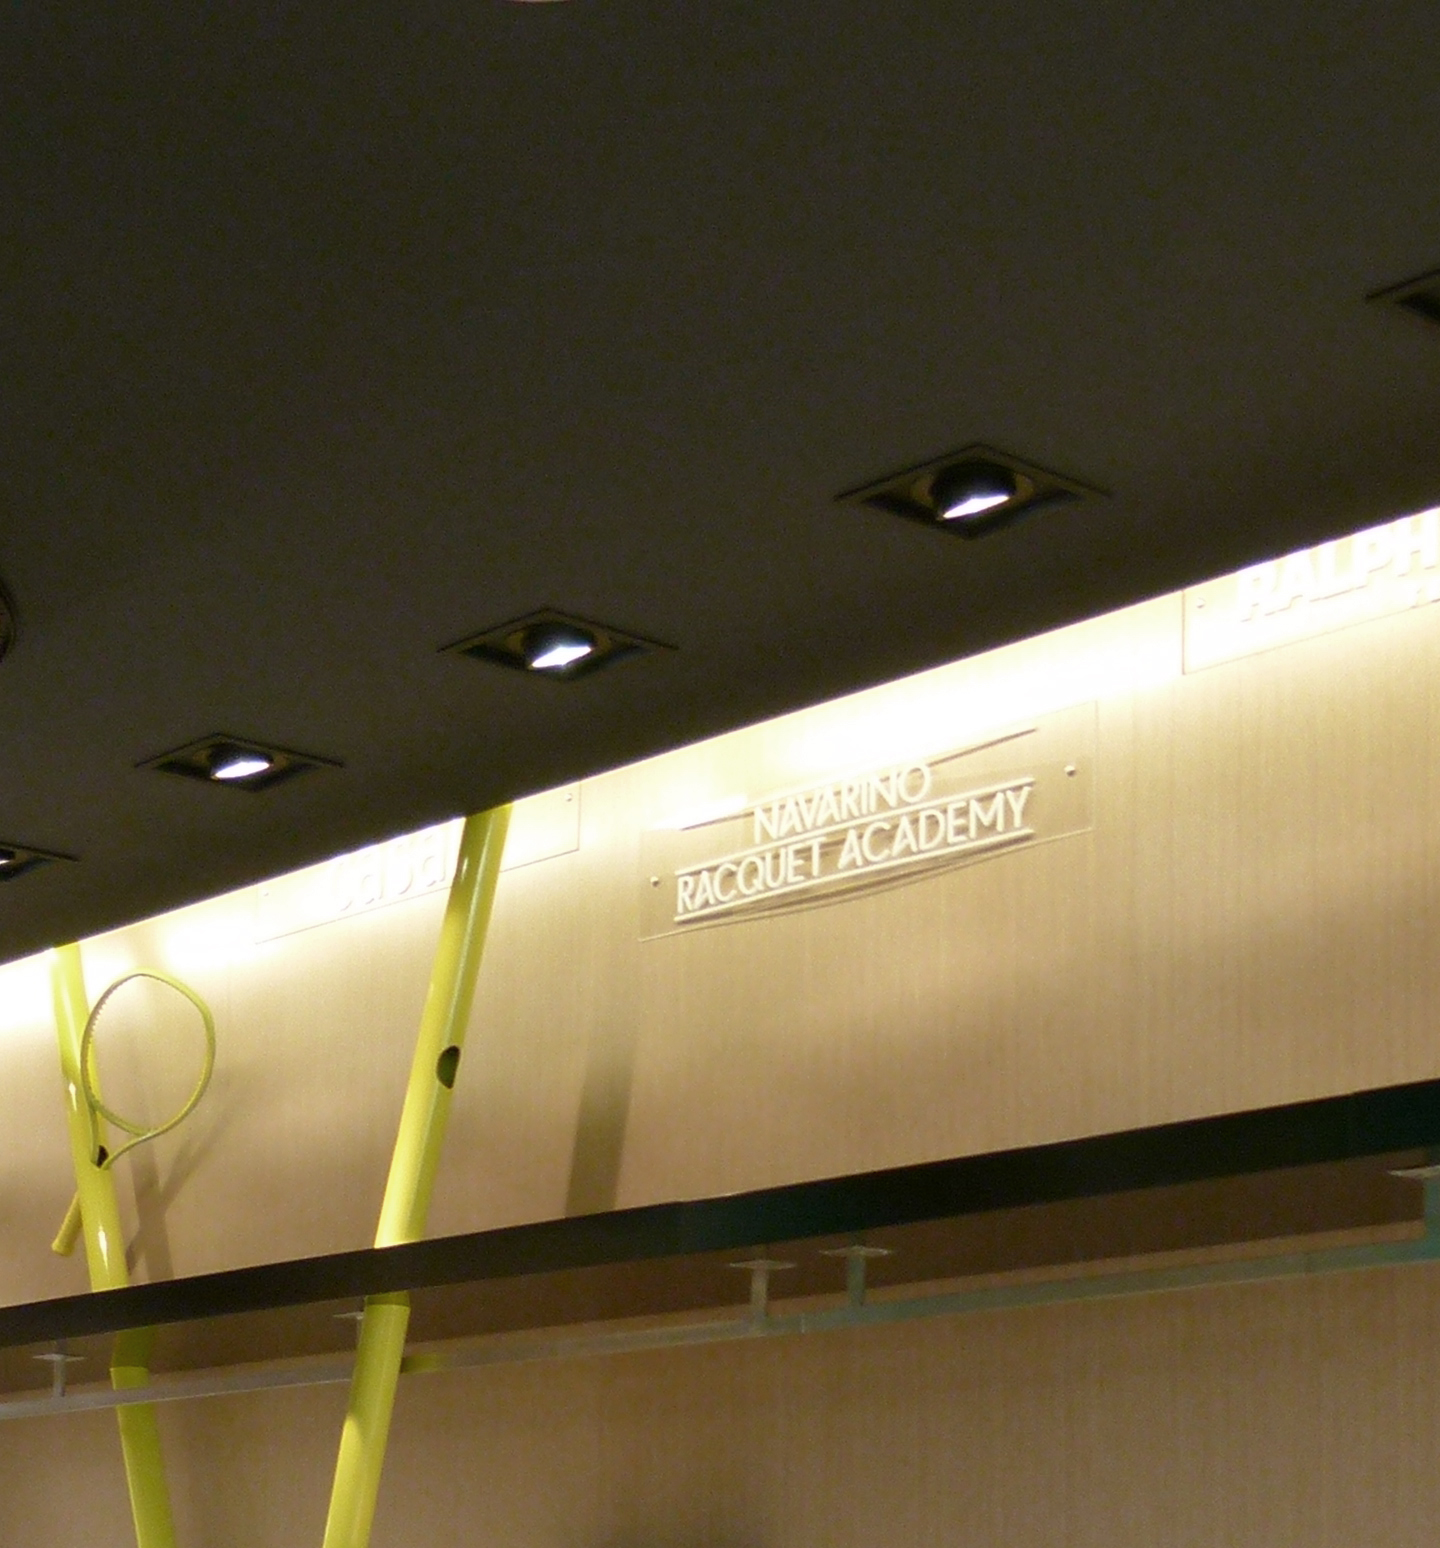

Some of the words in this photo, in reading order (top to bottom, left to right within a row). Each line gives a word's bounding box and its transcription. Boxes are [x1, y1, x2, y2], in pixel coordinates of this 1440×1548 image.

[677, 837, 826, 913] RACQUET
[838, 786, 1033, 869] ACADEMY
[754, 763, 932, 844] NAVARINO
